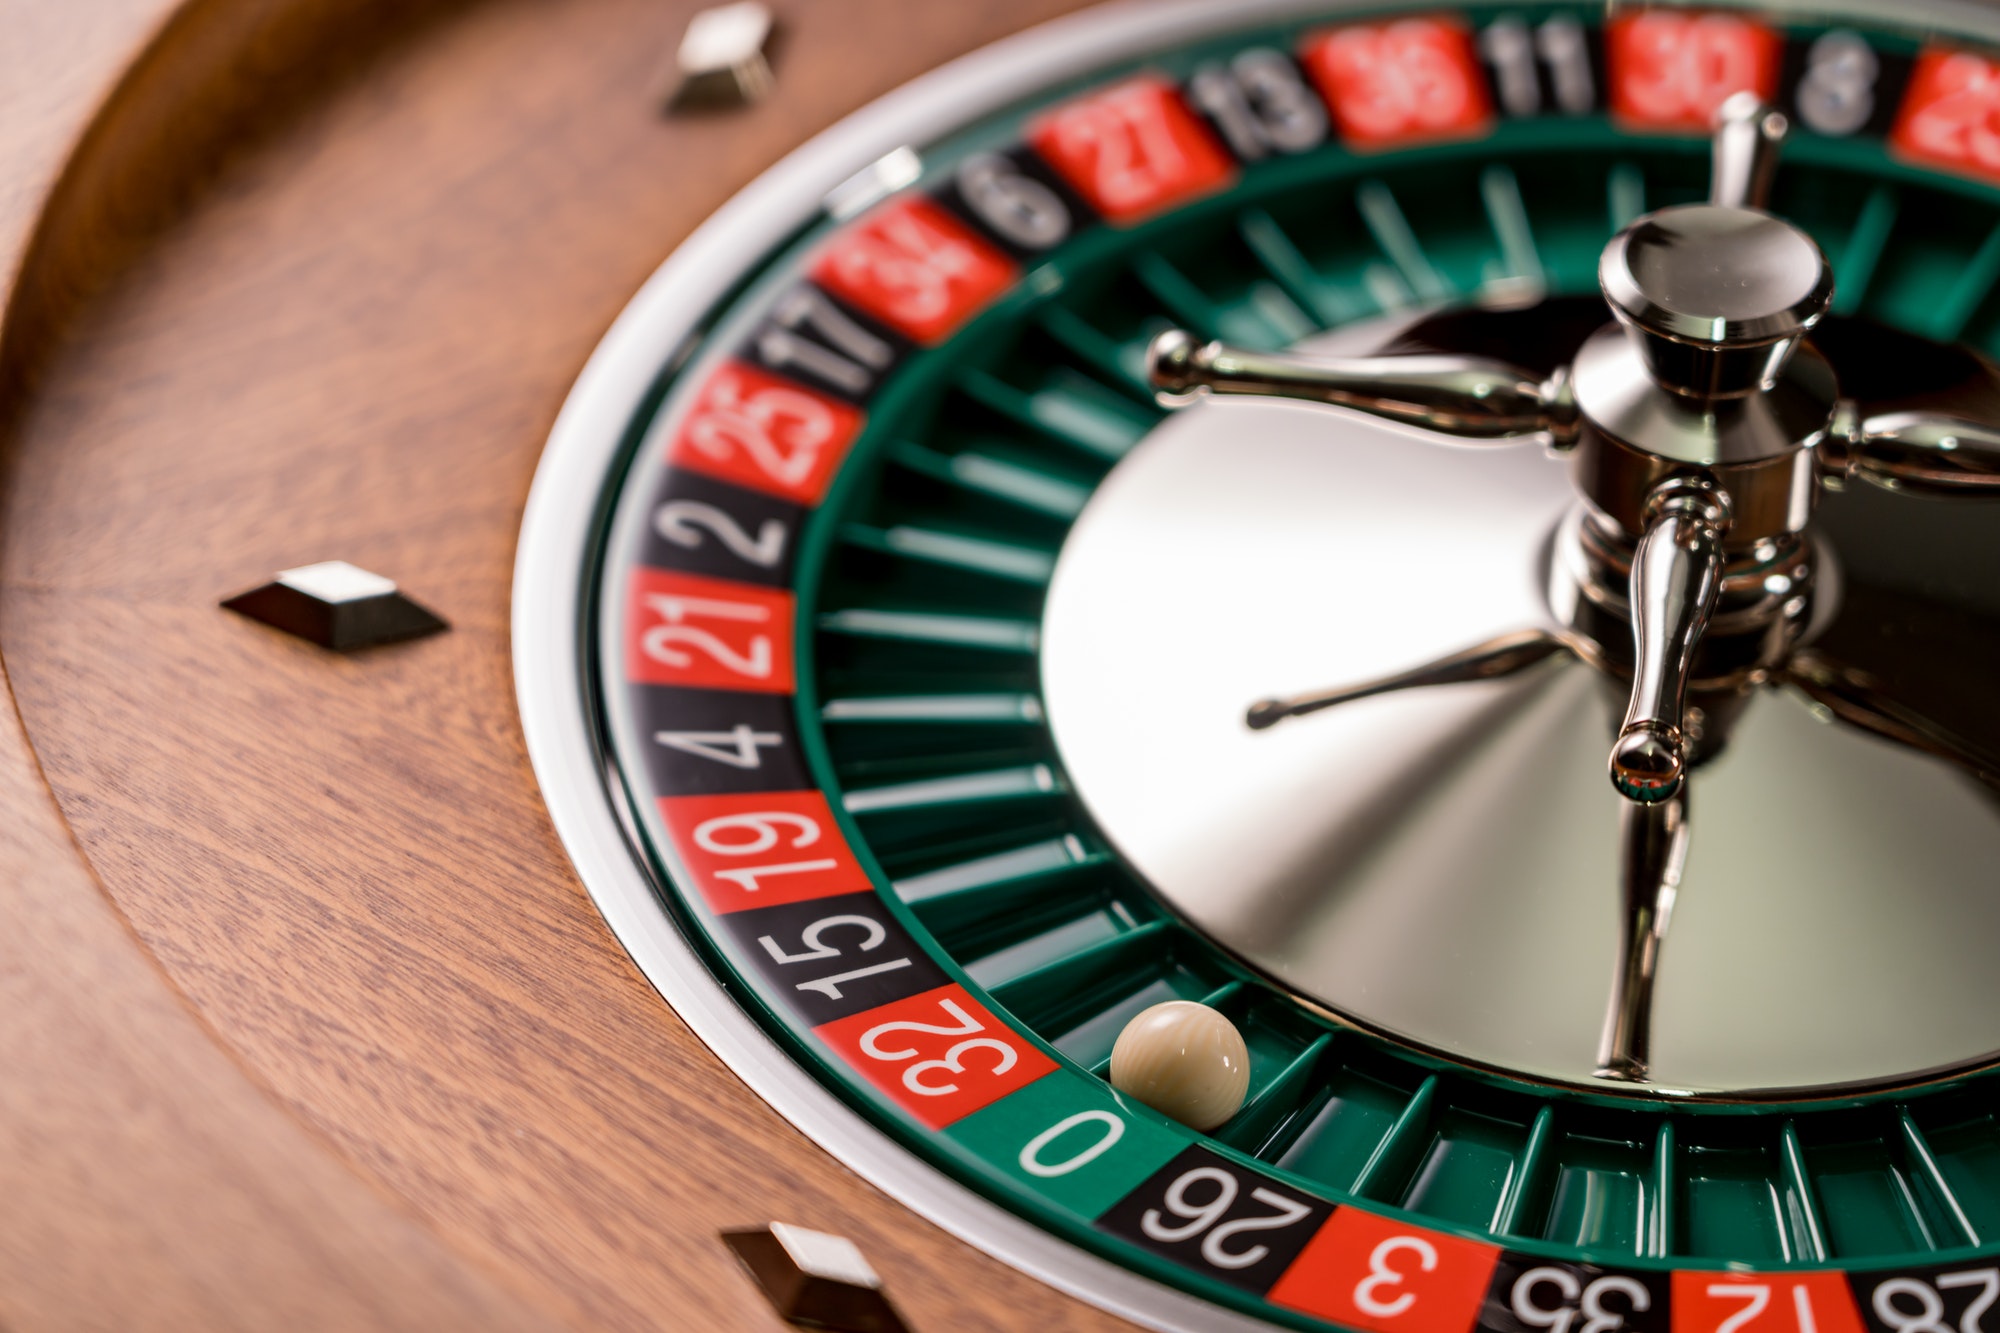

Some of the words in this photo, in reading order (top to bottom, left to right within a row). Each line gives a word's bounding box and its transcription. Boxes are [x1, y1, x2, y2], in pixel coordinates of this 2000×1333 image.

[1478, 17, 1595, 116] 11
[1796, 28, 1878, 137] 8
[957, 151, 1071, 249] 6
[757, 285, 893, 393] 17
[690, 370, 835, 486] 25
[656, 501, 786, 566] 2
[642, 593, 771, 678] 21
[655, 726, 782, 769] 4
[693, 812, 838, 892] 19
[757, 914, 913, 1000] 15
[859, 998, 1018, 1096] 32
[1018, 1110, 1125, 1177] 0
[1141, 1167, 1313, 1269] 26
[1353, 1236, 1437, 1317] 3
